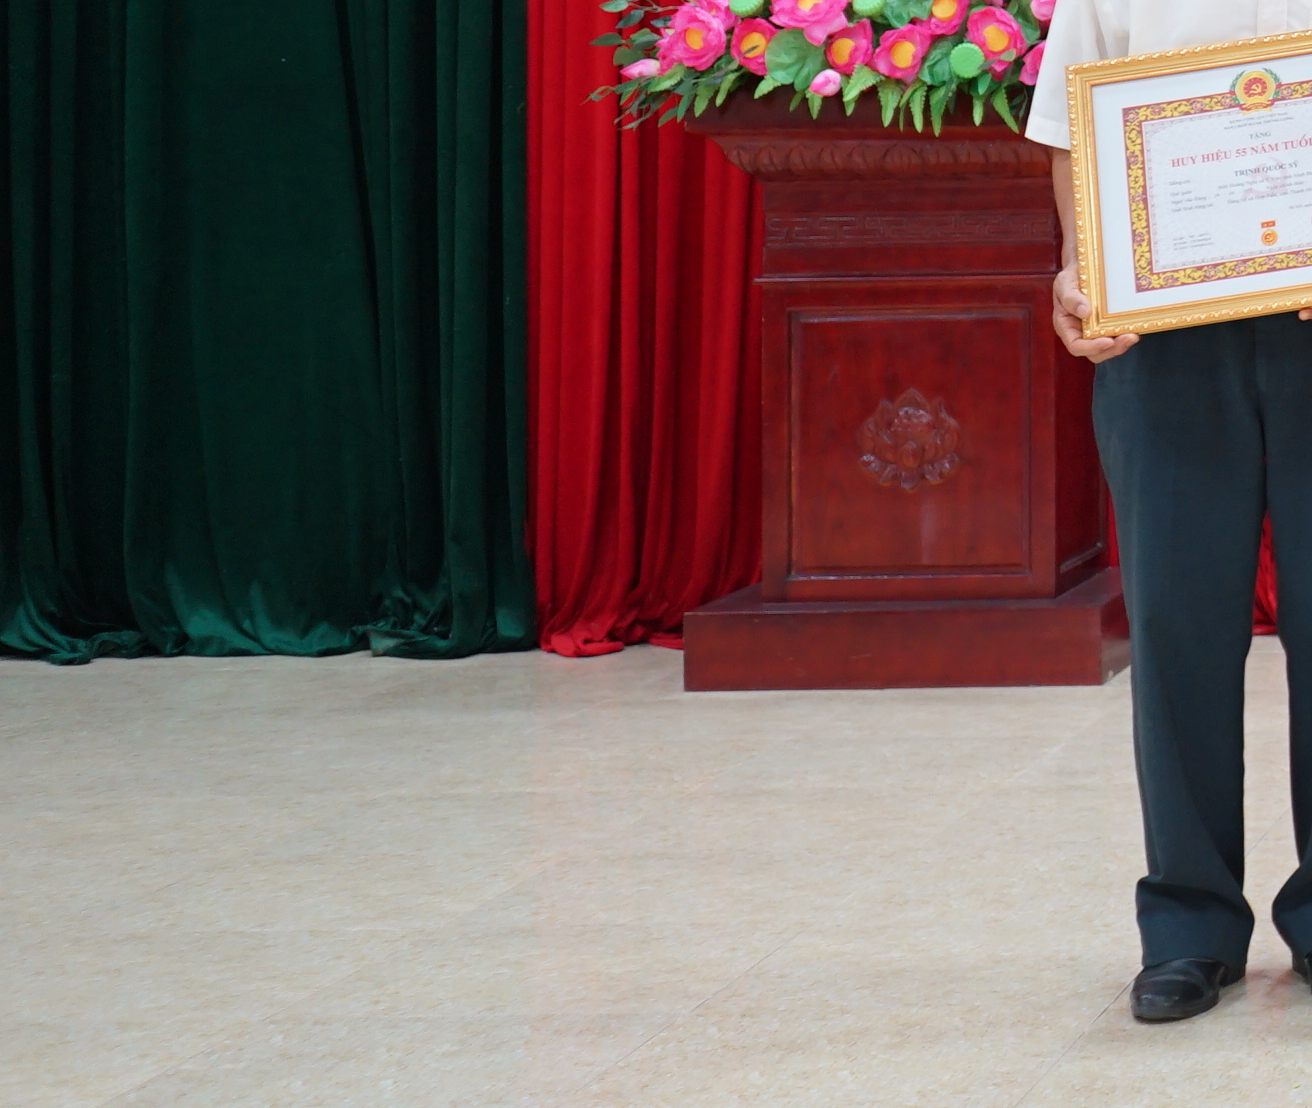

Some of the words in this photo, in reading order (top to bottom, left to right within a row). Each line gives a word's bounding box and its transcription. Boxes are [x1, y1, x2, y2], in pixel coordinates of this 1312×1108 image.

[1171, 155, 1199, 168] HUY
[1201, 149, 1232, 163] HIỆU
[1235, 148, 1248, 158] 55
[1250, 141, 1280, 155] NĂM
